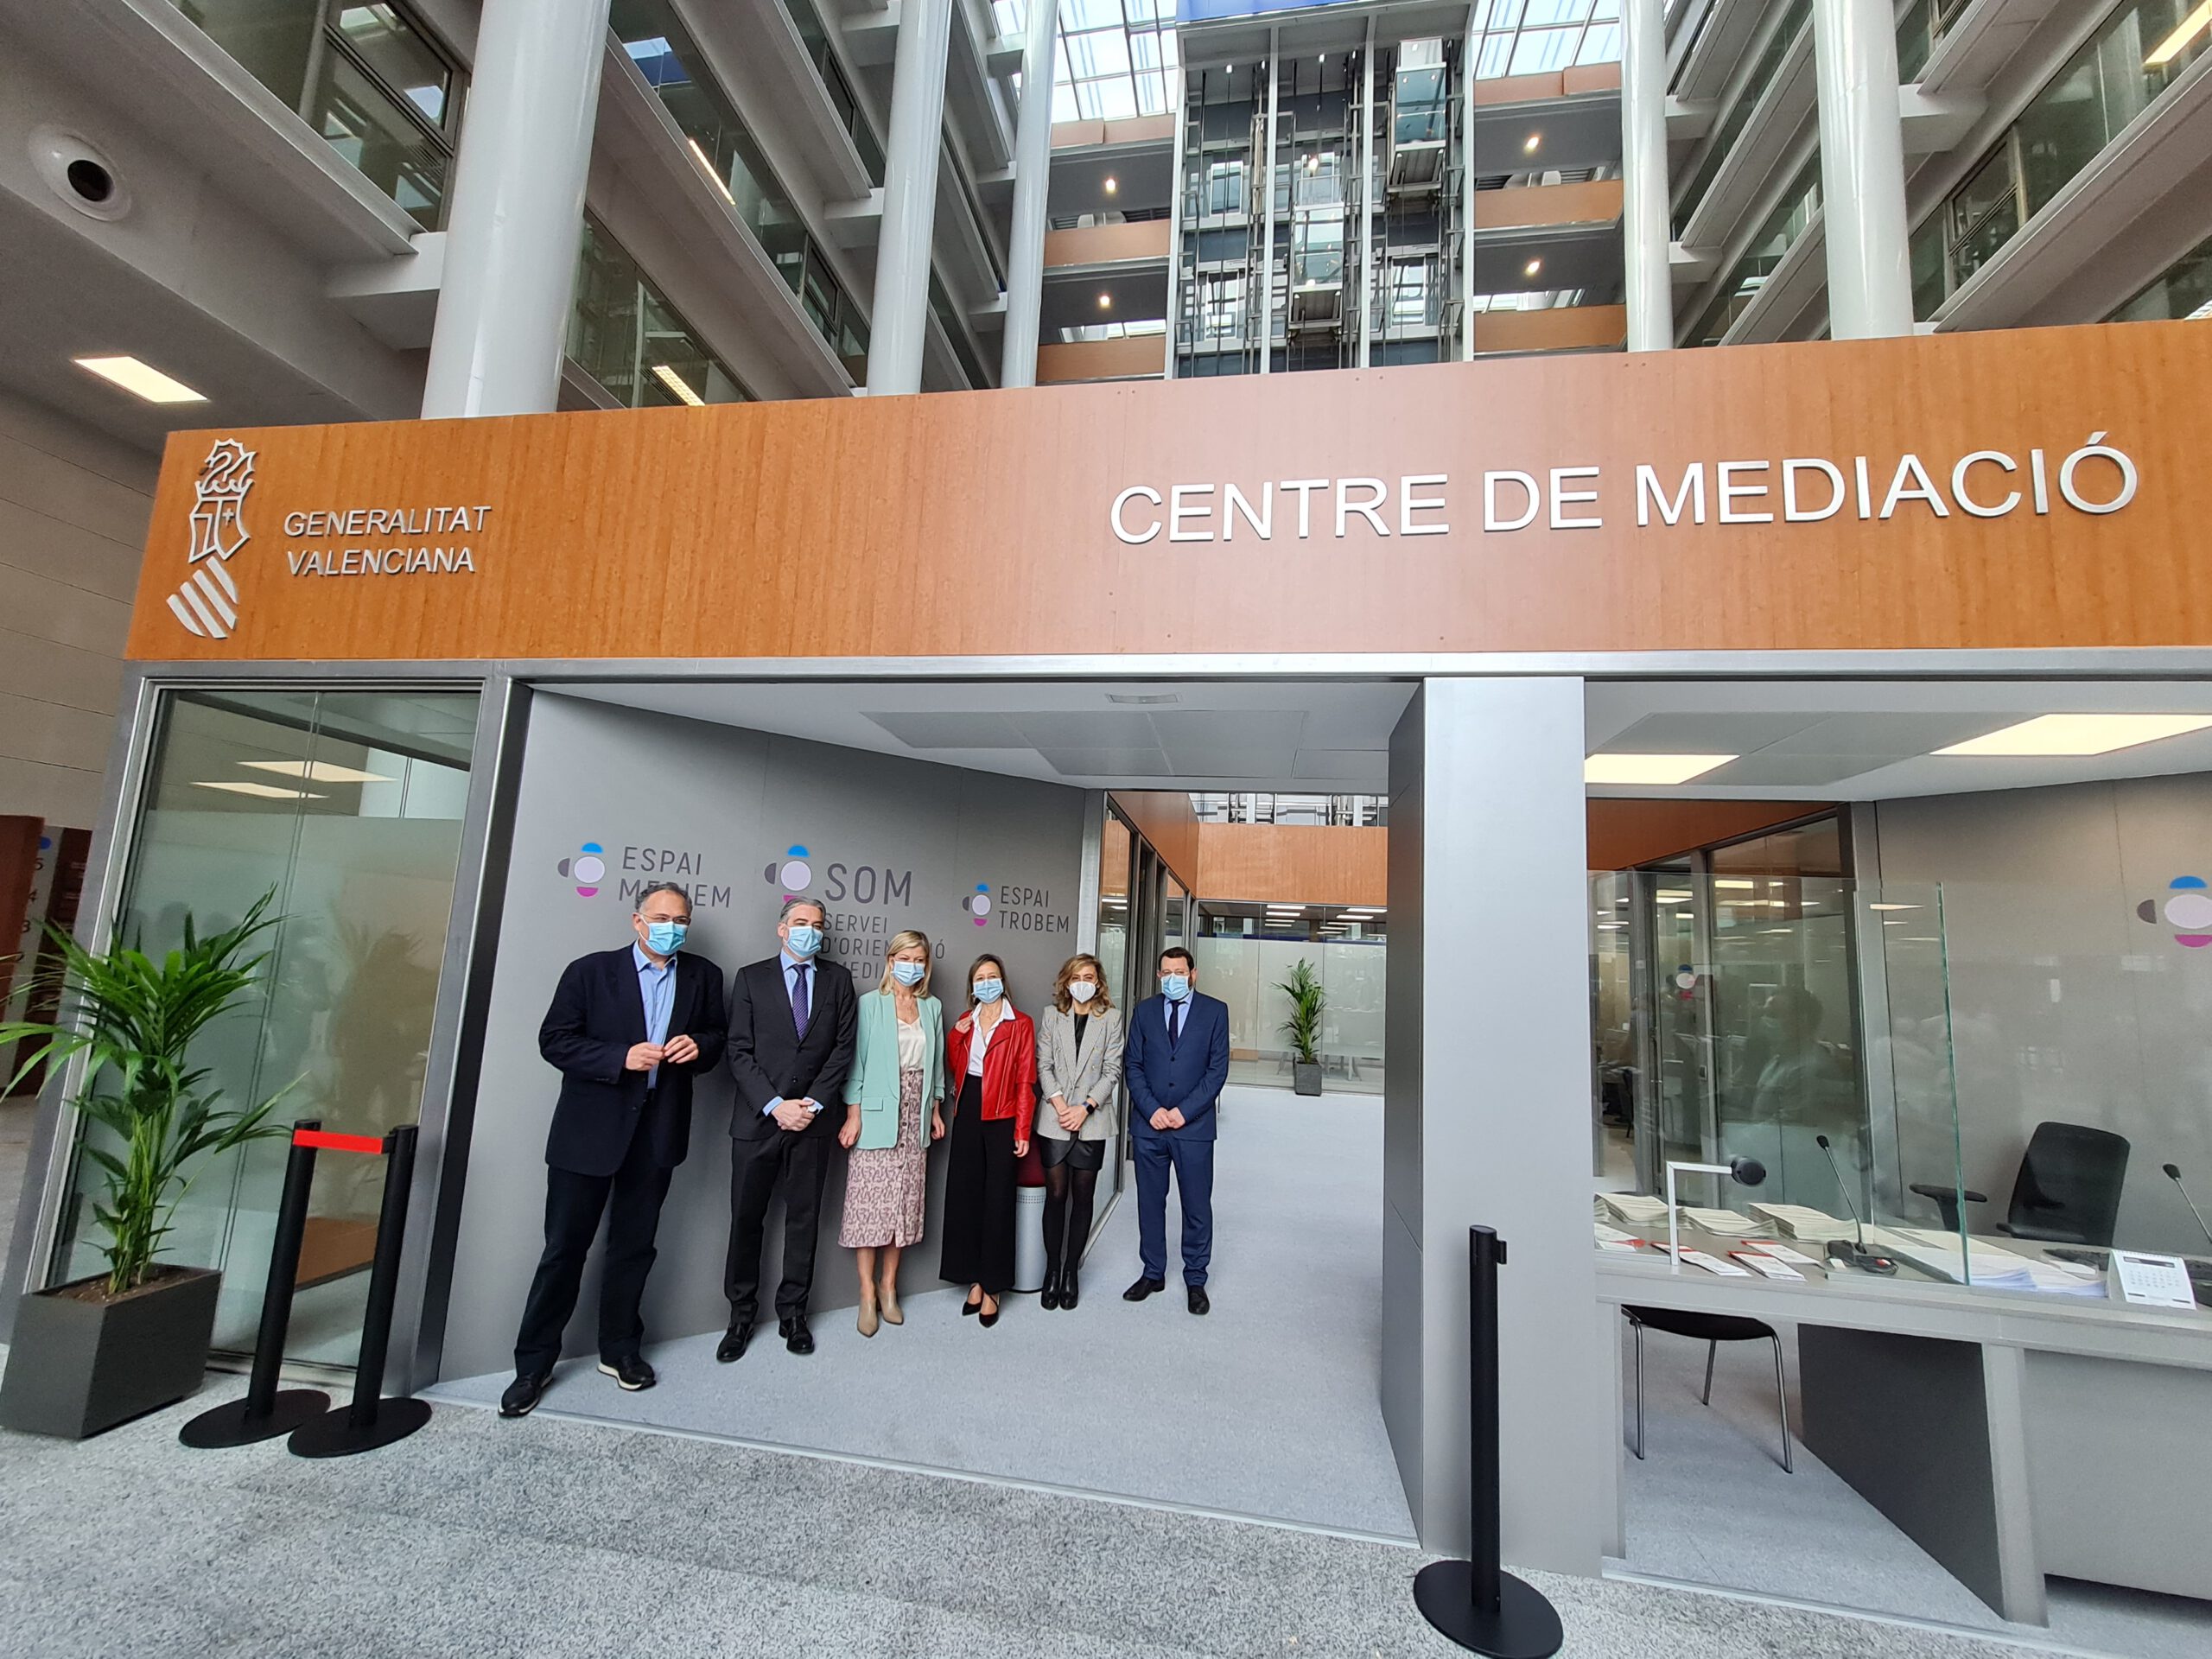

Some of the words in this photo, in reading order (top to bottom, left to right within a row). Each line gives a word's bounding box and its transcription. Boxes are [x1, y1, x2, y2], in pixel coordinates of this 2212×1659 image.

[1110, 474, 1449, 543] CENTRE
[1484, 467, 1602, 531] DE
[1636, 431, 2138, 526] MEDIACIÓ
[283, 505, 492, 537] GENERALITAT
[287, 547, 475, 576] VALENCIANA
[622, 846, 701, 875] ESPAI
[825, 863, 912, 906] SOM
[1001, 886, 1049, 908] ESPAI
[824, 912, 887, 933] SERVEI
[999, 910, 1069, 933] TROBEM
